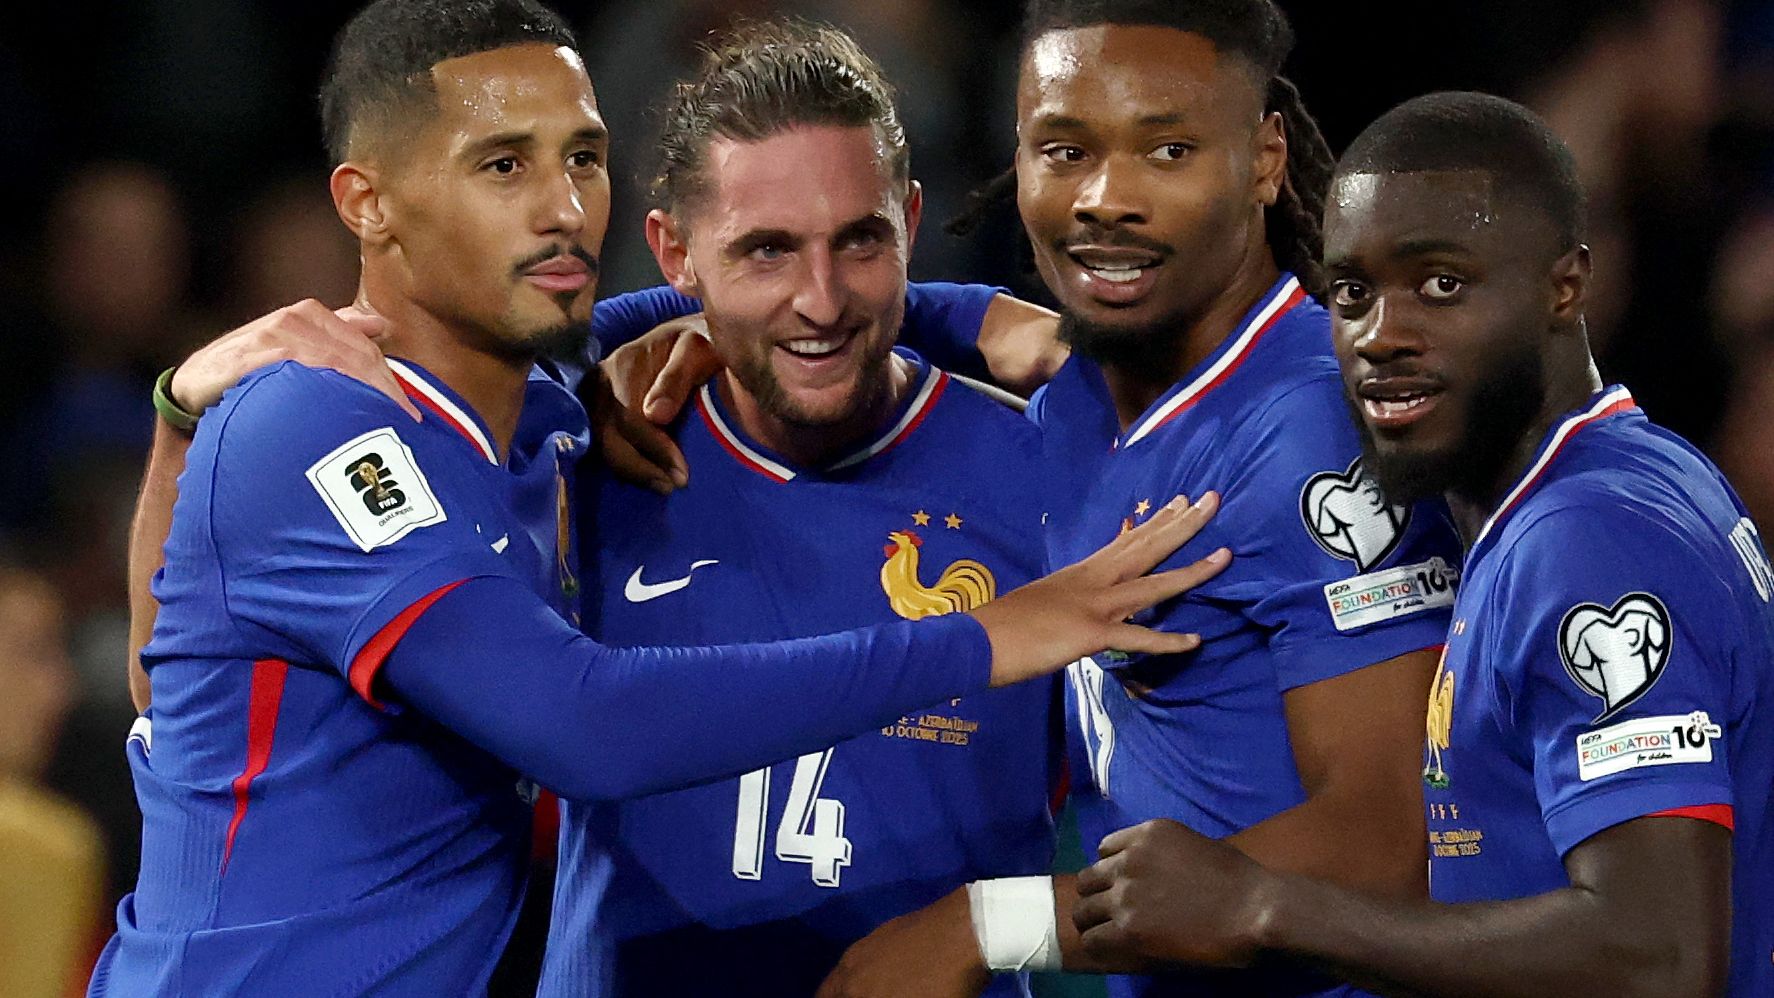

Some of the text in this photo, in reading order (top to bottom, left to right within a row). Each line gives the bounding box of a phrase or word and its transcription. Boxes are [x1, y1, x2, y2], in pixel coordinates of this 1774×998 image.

[1581, 734, 1602, 745] UEFA
[1582, 733, 1671, 763] FOUNDATION
[1672, 724, 1706, 749] 10
[1637, 752, 1673, 764] for children
[732, 746, 853, 888] 14
